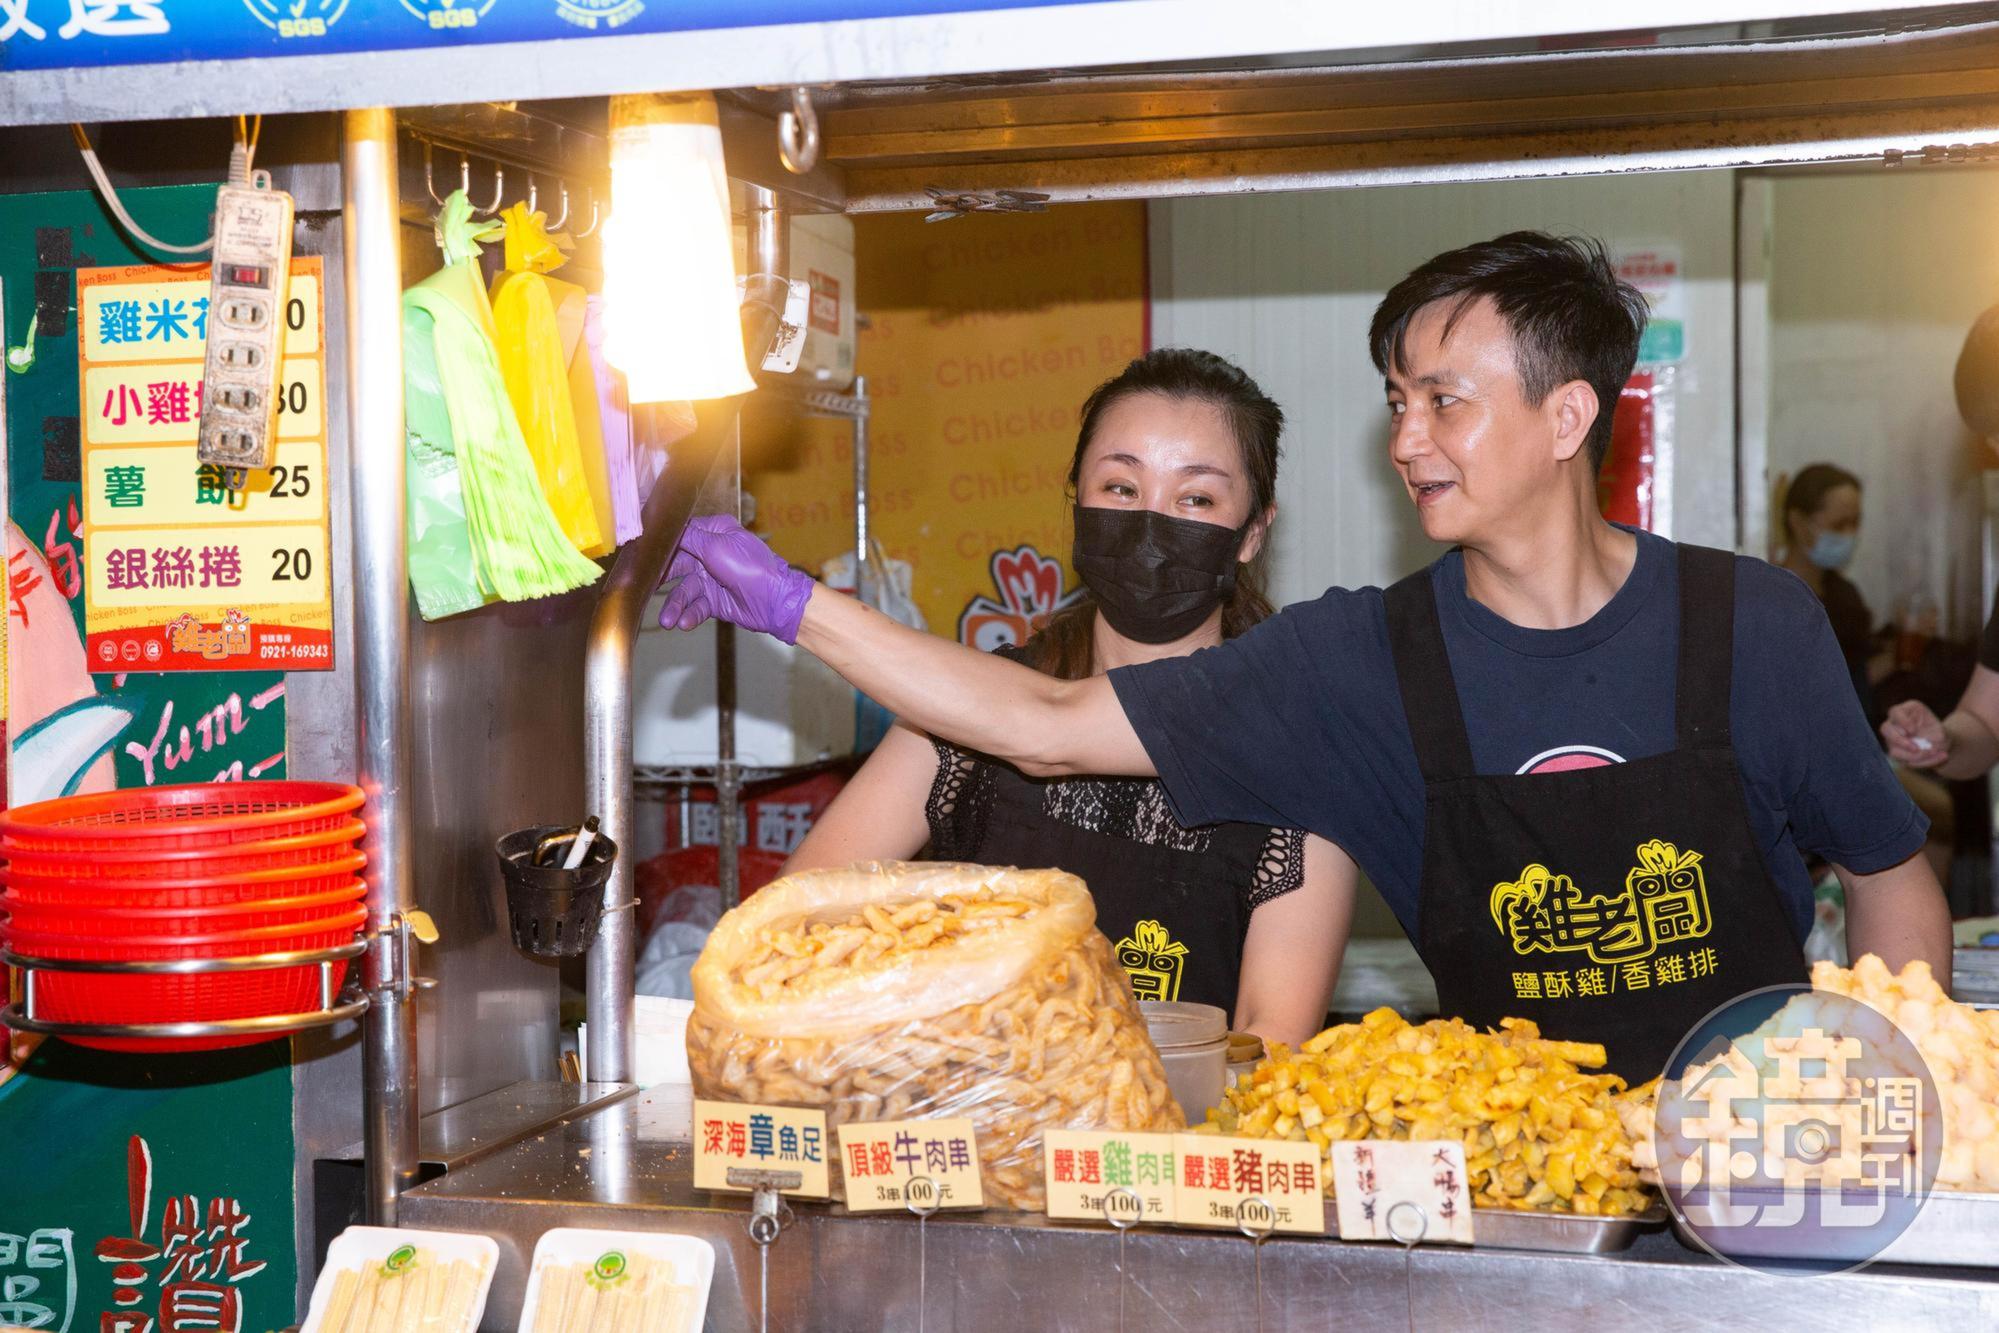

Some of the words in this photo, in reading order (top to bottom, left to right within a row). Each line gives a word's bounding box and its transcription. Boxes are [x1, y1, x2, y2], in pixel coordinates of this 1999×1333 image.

[278, 18, 327, 38] SGS
[428, 8, 478, 29] SGS
[935, 343, 1087, 388] Chicken
[101, 380, 204, 426] 小雞
[268, 464, 311, 499] 25
[105, 545, 243, 591] 銀絲捲
[271, 547, 313, 582] 20
[260, 645, 329, 660] 0921-169343
[125, 699, 250, 786] Yum
[1490, 838, 1712, 965] 雞老闆
[1511, 946, 1720, 1000] 鹽酥雞/香雞排
[703, 1113, 823, 1164] 深海章魚足
[845, 1130, 972, 1178] 頂級牛肉串
[1183, 1148, 1317, 1196] 嚴選豬肉串
